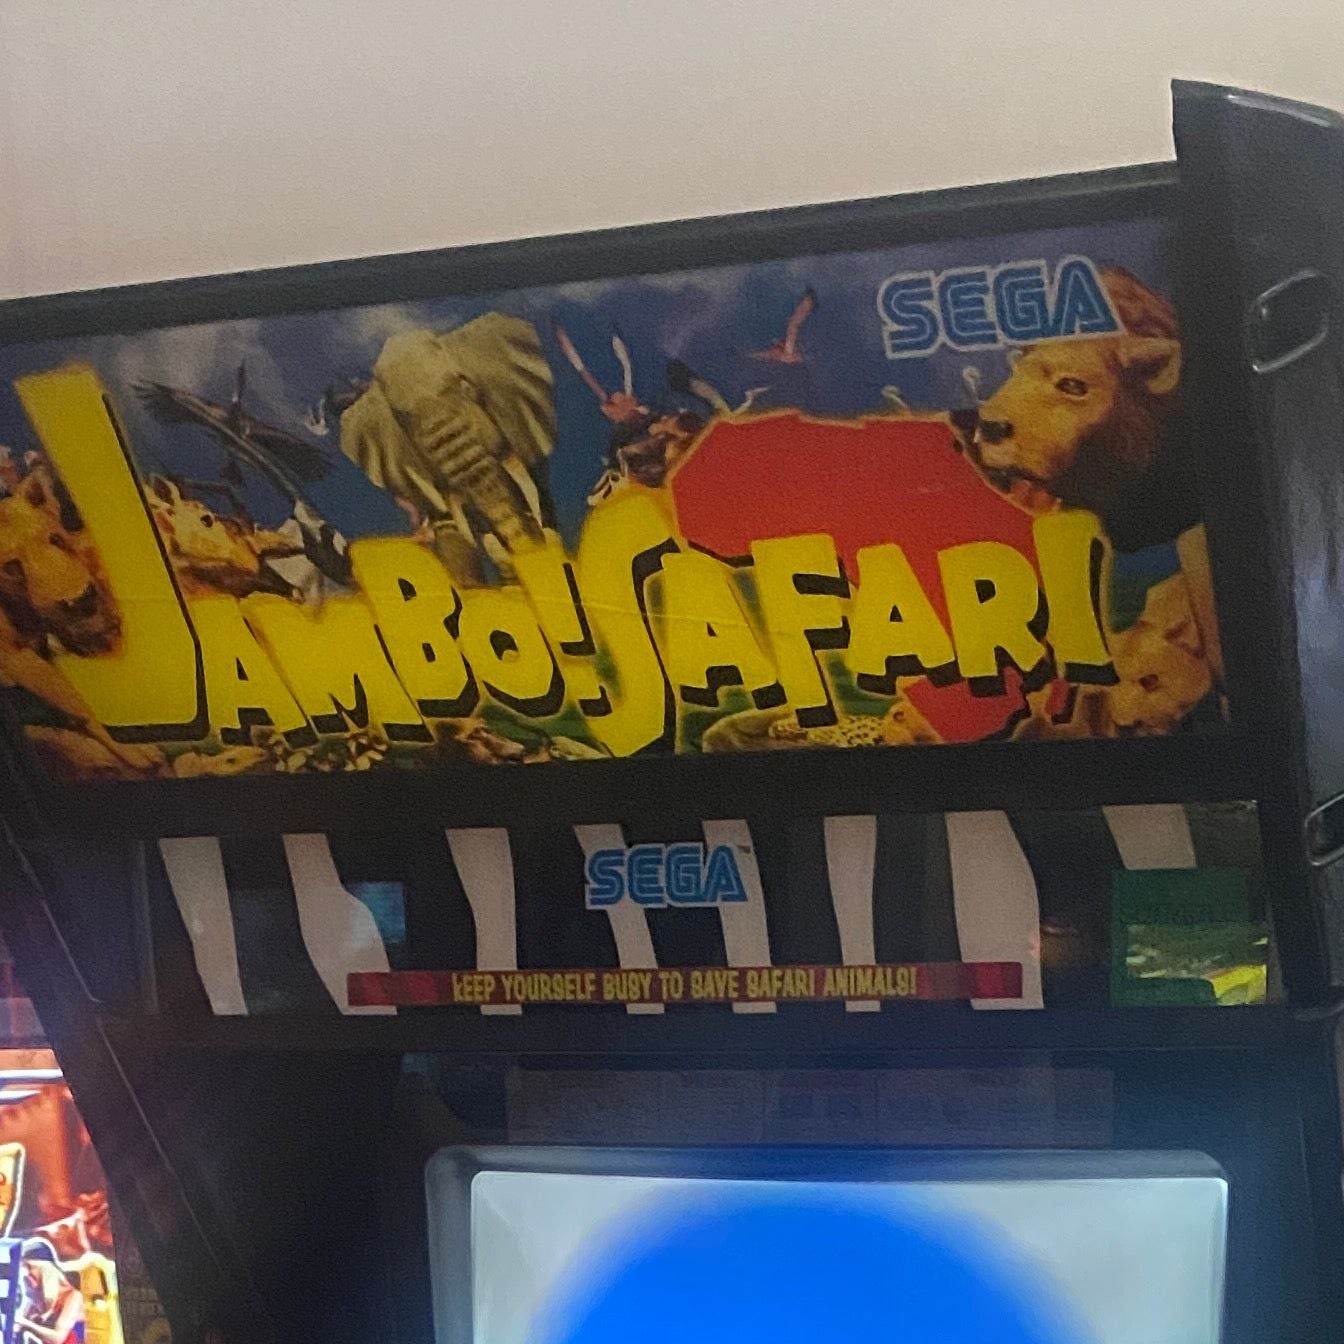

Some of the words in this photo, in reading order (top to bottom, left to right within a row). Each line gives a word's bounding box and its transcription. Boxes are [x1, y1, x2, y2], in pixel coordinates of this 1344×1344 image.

[877, 255, 1122, 360] SEGA
[578, 487, 1120, 759] SAFARI
[585, 842, 749, 910] SEGA
[502, 970, 596, 1002] YOURSELF
[602, 968, 652, 1001] BUSY
[659, 970, 682, 1000] TO
[690, 968, 741, 999] SAVE
[746, 967, 815, 998] SAFARI
[823, 966, 917, 997] ANIMALS!
